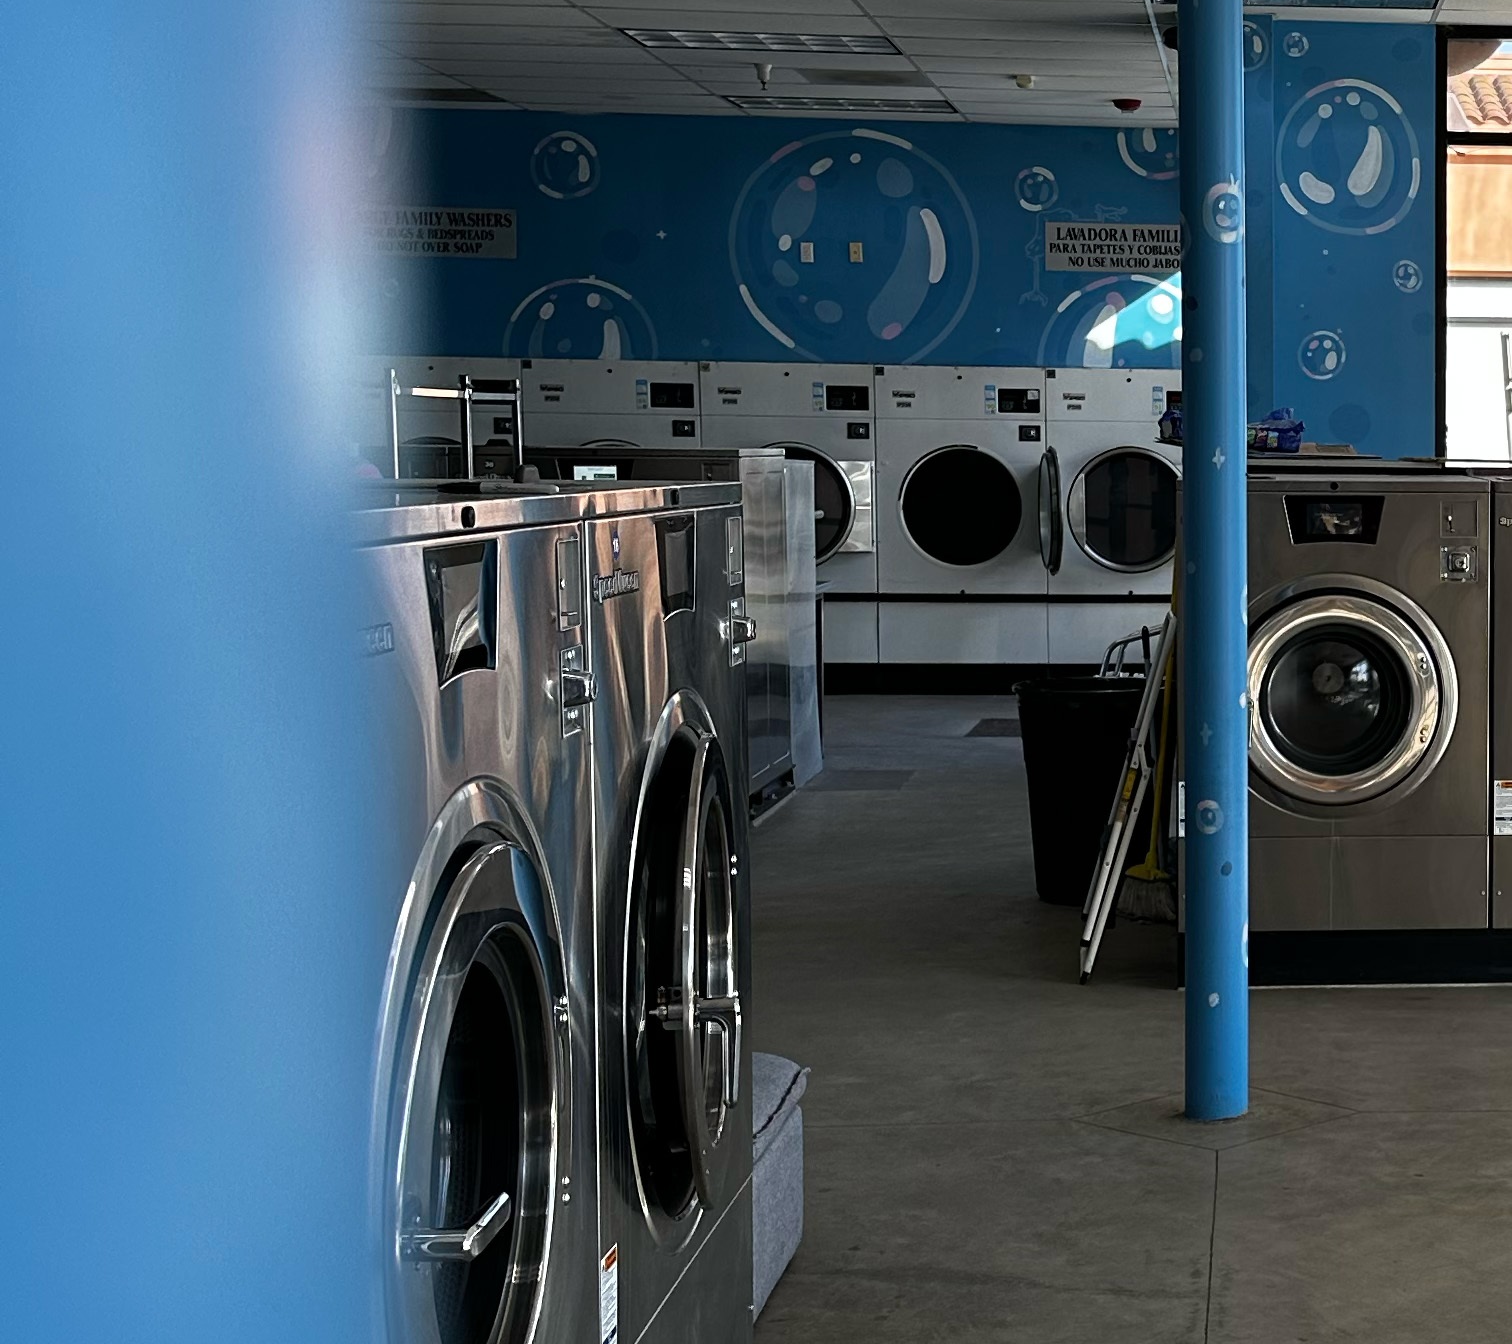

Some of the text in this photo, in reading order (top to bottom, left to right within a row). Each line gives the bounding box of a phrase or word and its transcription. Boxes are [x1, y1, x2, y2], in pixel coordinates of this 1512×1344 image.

[396, 211, 444, 226] FAMILY
[447, 212, 513, 228] WASHERS
[427, 229, 495, 241] BEDSPREADS
[1056, 227, 1128, 242] LAVADORA
[398, 242, 419, 253] NOT
[422, 242, 451, 253] OVER
[453, 242, 483, 254] SOAP
[1049, 242, 1180, 256] PARA TAPETES Y COBIJAS
[1068, 256, 1084, 267] NO
[1087, 257, 1107, 268] USE
[1109, 257, 1150, 268] MUCHO
